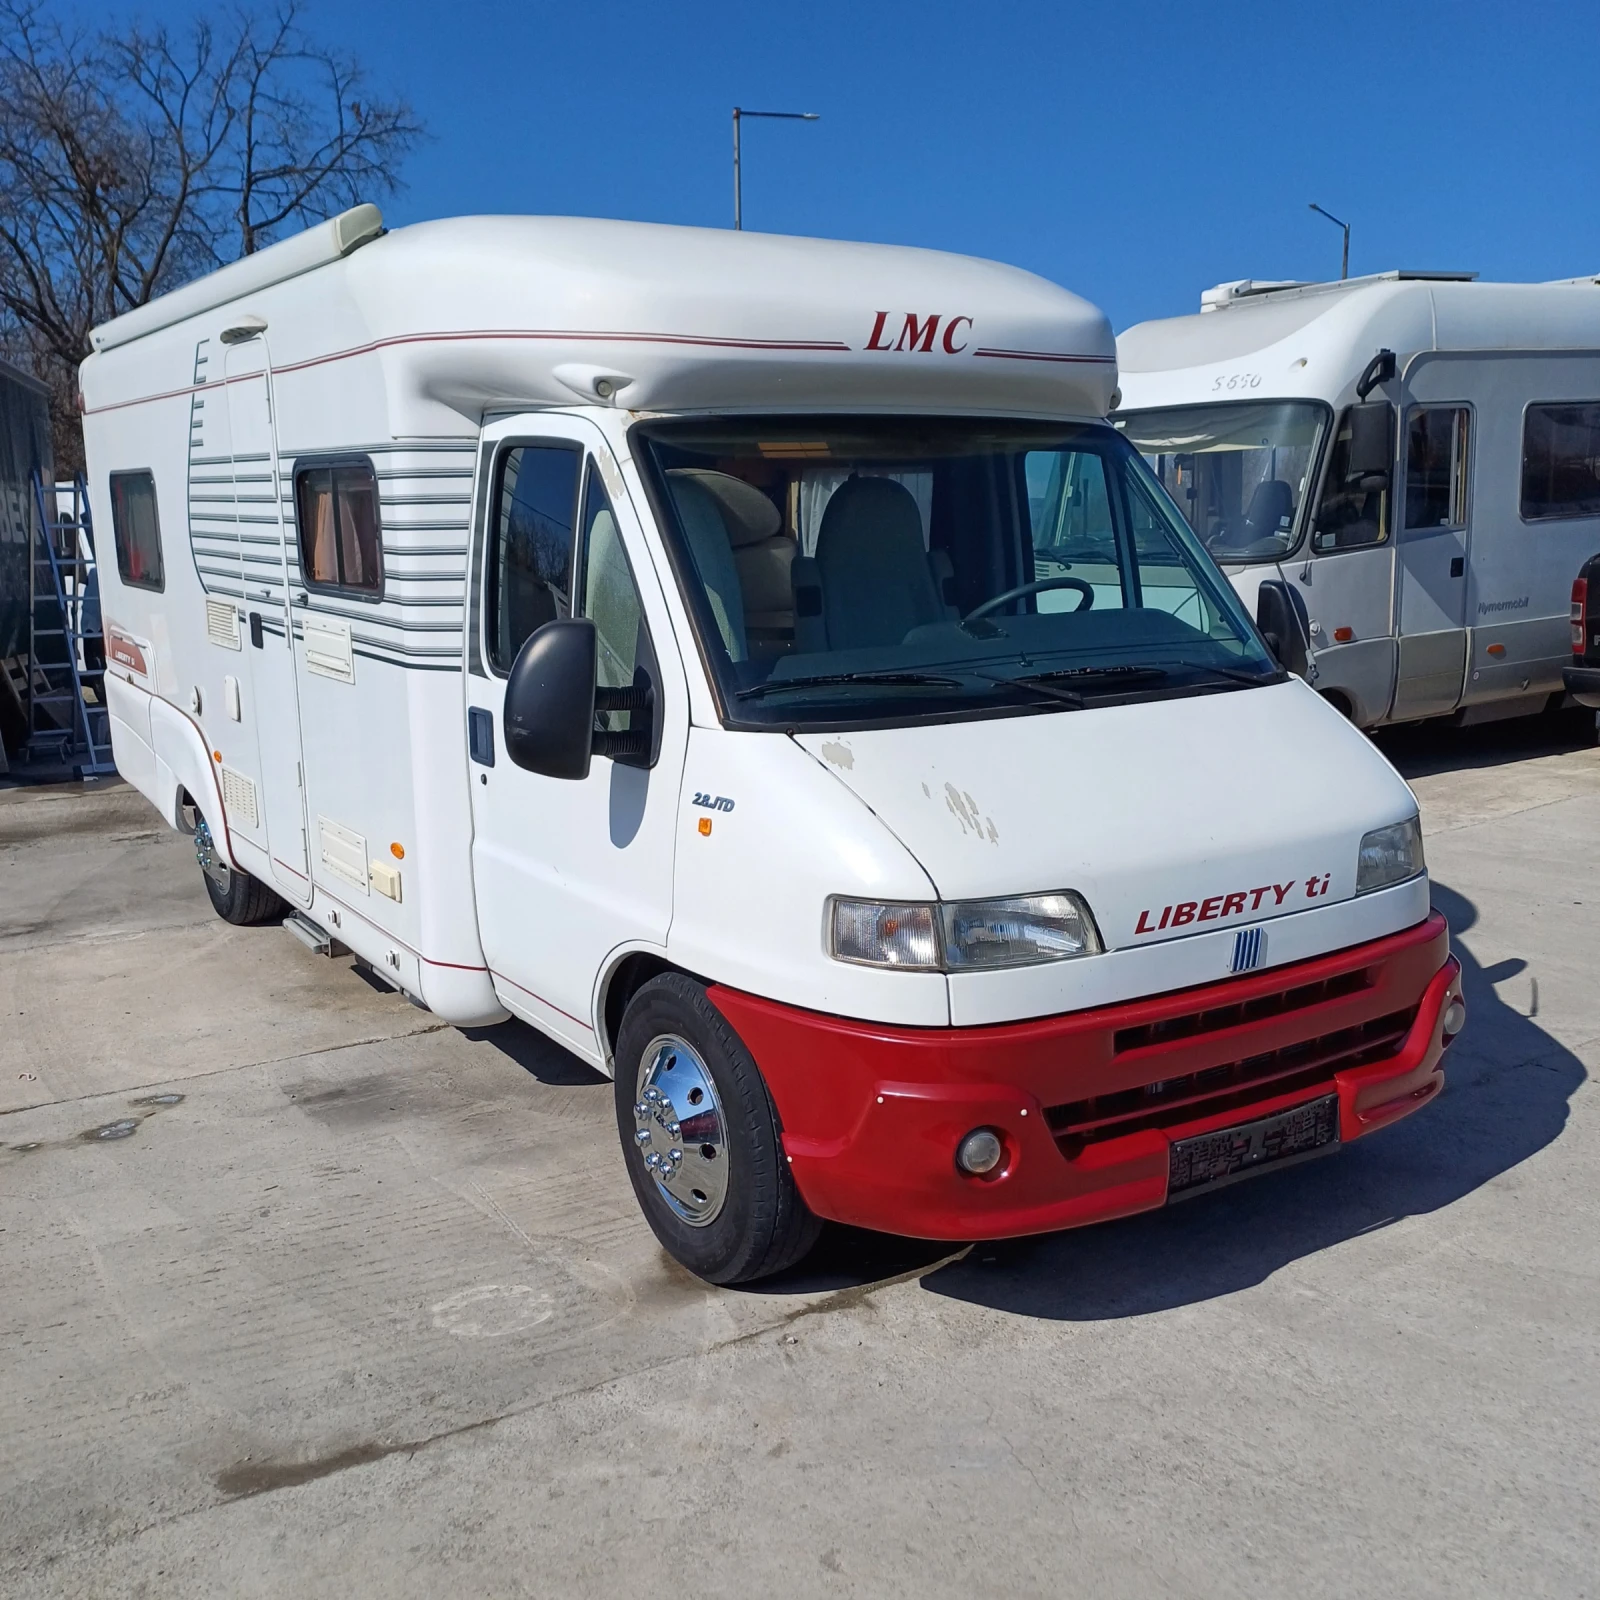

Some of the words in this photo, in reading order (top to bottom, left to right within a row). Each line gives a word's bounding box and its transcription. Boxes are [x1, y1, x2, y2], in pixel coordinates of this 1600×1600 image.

[863, 311, 974, 354] LMC
[1134, 880, 1296, 934] LIBERTY
[1305, 873, 1331, 898] ti
